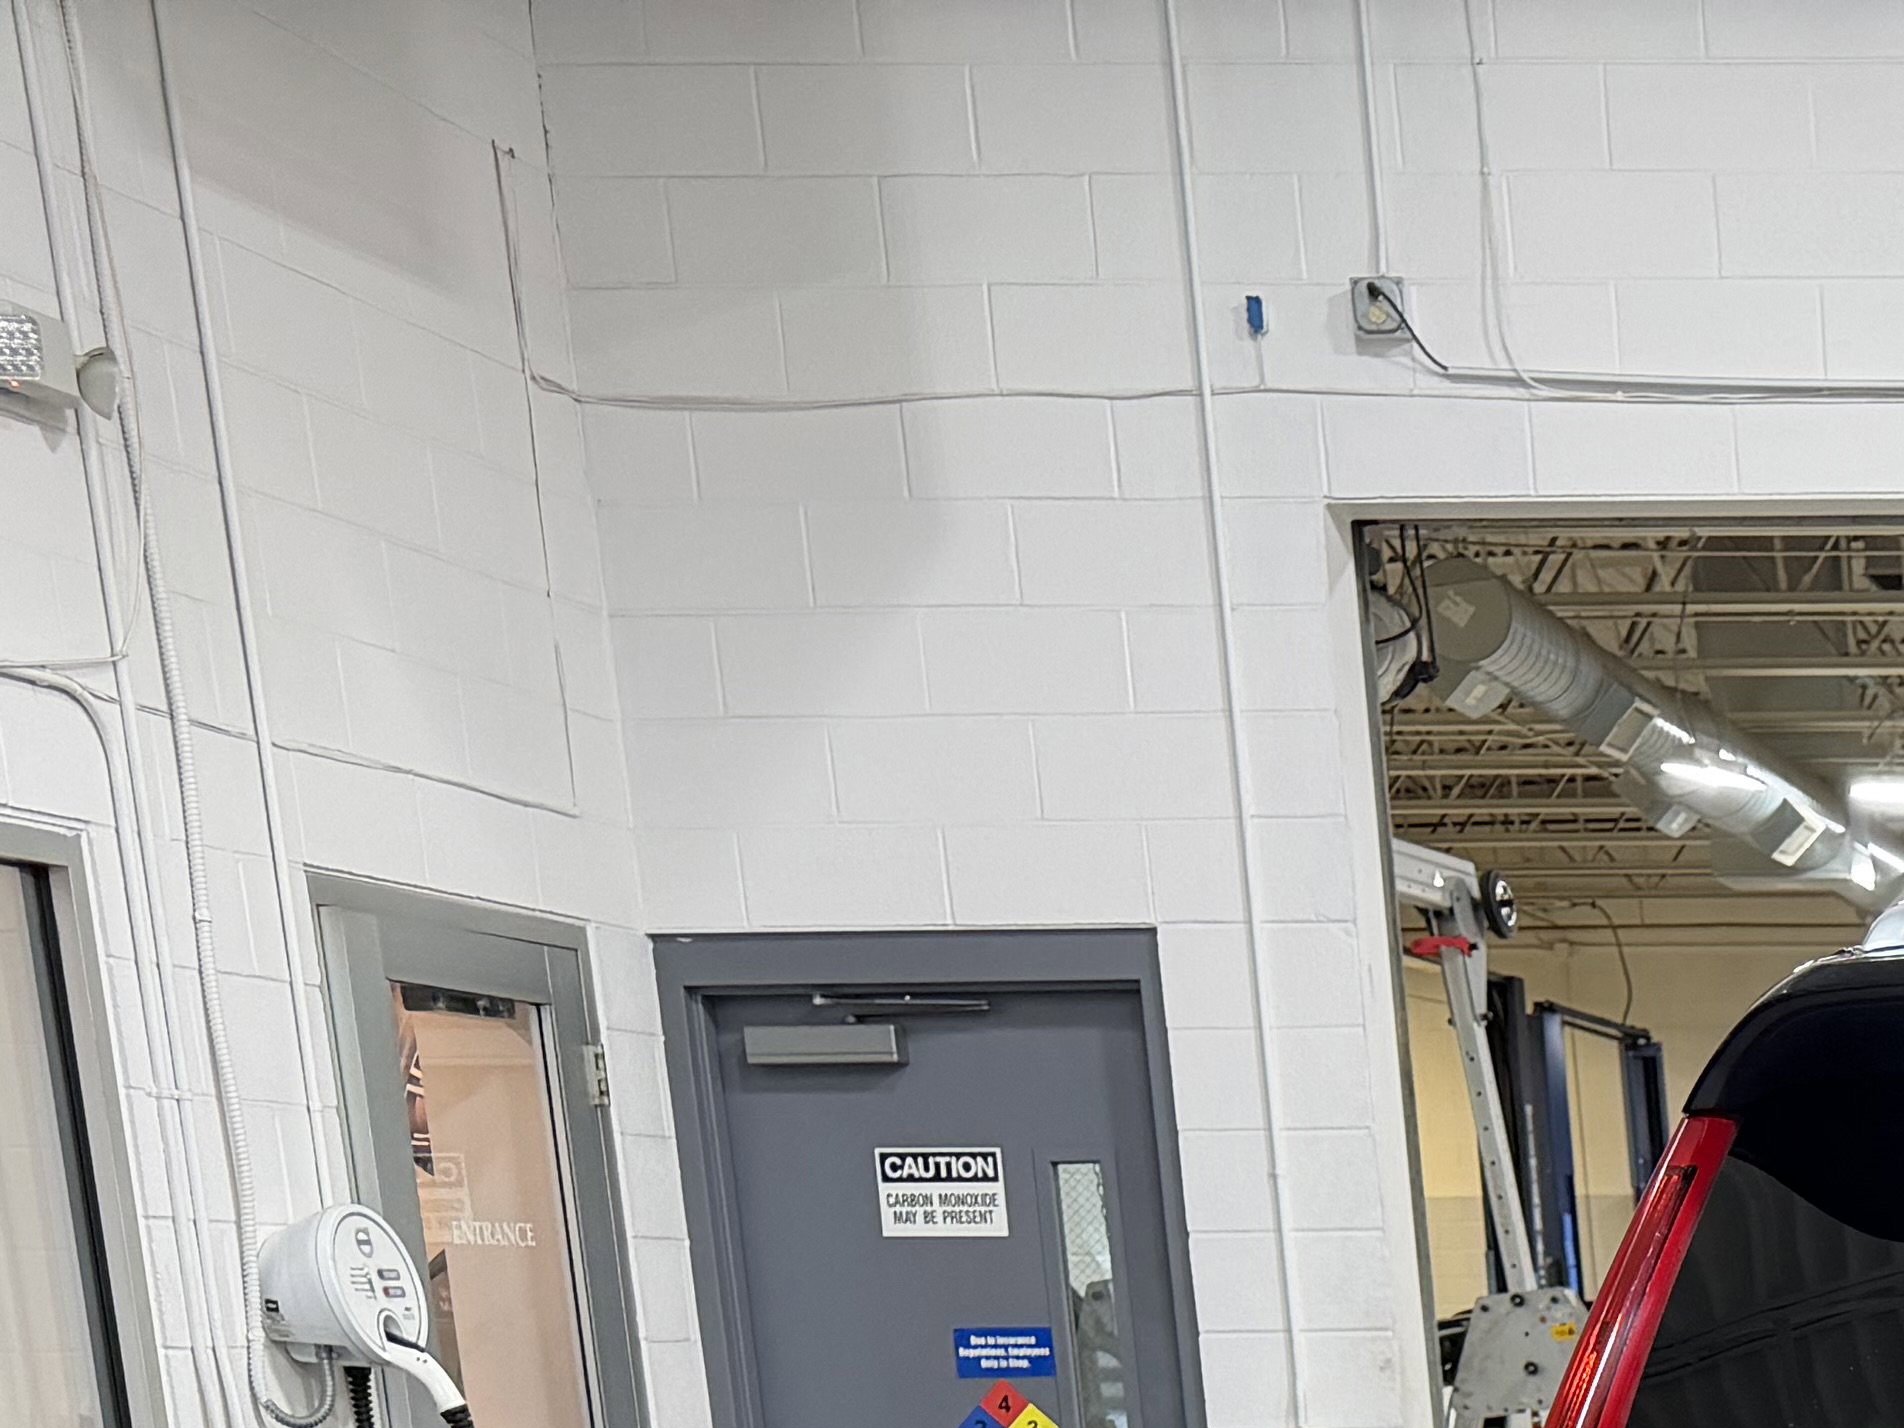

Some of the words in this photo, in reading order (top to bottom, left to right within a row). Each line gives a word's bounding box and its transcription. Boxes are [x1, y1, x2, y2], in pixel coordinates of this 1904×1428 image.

[884, 1156, 995, 1178] CAUTION
[886, 1193, 933, 1207] CARBON
[938, 1193, 1000, 1207] MONOXIDE
[893, 1210, 918, 1224] MAY
[923, 1210, 938, 1224] BE
[942, 1210, 994, 1224] PRESENT
[451, 1221, 536, 1247] ENTRANCE
[998, 1394, 1011, 1413] 4
